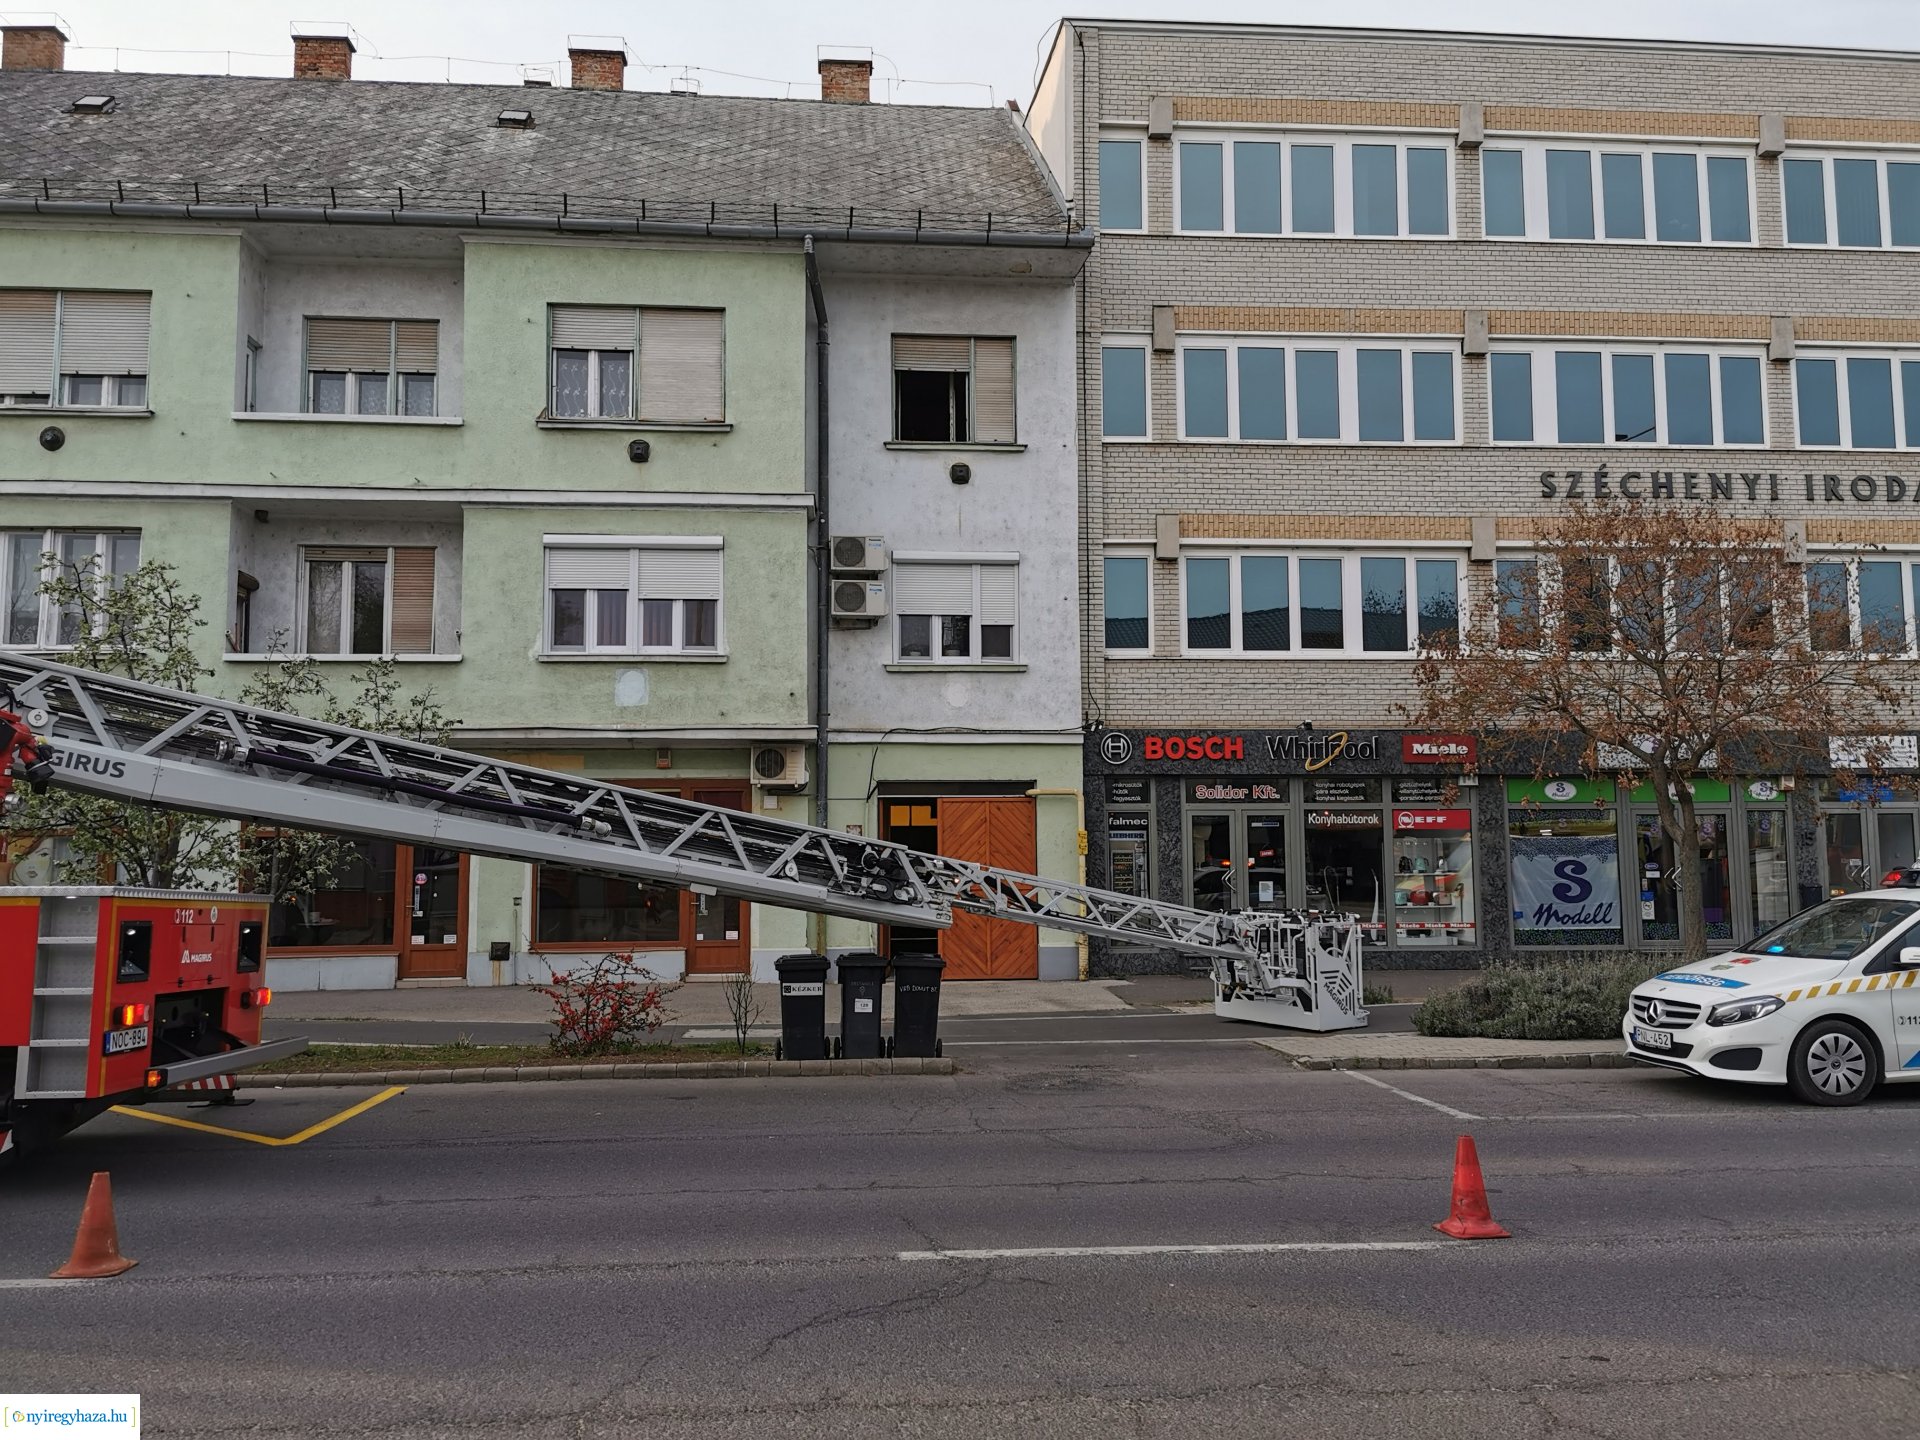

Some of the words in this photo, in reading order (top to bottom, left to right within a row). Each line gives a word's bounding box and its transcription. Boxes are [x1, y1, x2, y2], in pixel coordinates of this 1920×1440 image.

[1540, 463, 1779, 500] SZÉCHENYI
[1144, 735, 1244, 760] BOSCH
[1266, 735, 1380, 766] Whirlpool
[1412, 743, 1469, 755] Miele
[1195, 784, 1249, 799] Solidor
[1252, 784, 1281, 799] Kft.
[1109, 817, 1148, 825] falmec
[1308, 813, 1379, 827] Konyhabútorok
[1552, 859, 1593, 904] S
[181, 909, 194, 924] 112
[1533, 902, 1614, 927] Modell
[191, 953, 213, 963] MAGIRUS
[1323, 982, 1349, 1015] MAGIRUS
[111, 1029, 147, 1050] NOC-894
[1637, 1029, 1670, 1046] PNL-452
